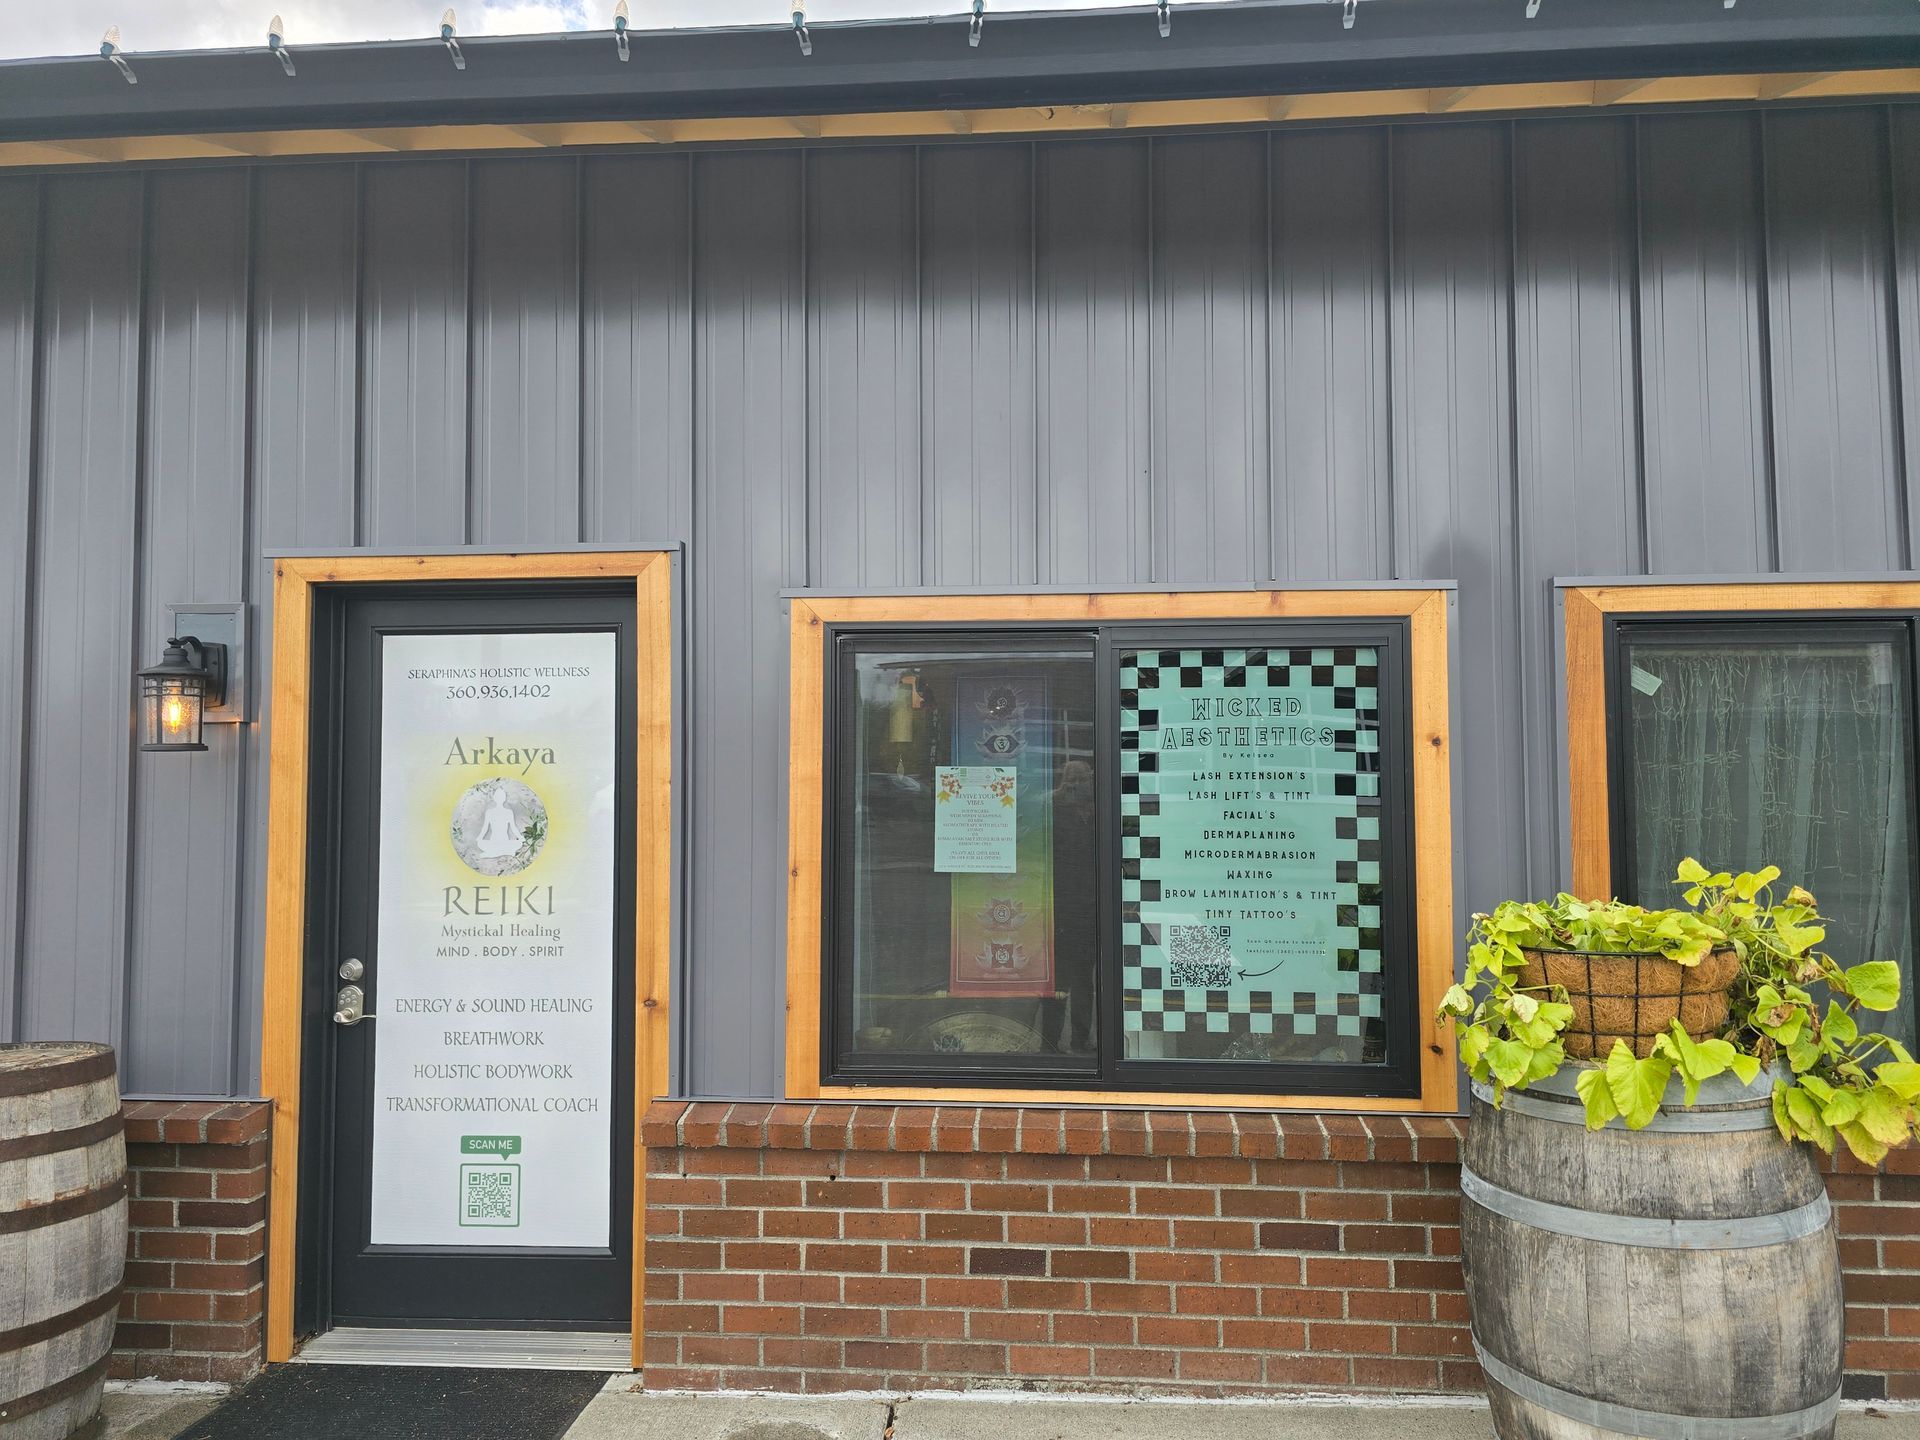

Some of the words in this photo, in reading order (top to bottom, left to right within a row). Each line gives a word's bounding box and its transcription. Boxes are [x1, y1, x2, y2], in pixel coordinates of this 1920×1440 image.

[407, 668, 477, 680] SERAPHINA'S
[479, 667, 531, 679] HOLISTIC
[533, 666, 590, 678] WELLNESS
[446, 684, 552, 701] 360.936.1402
[1191, 696, 1302, 722] WICKED
[1160, 725, 1335, 750] AESTHETICS
[443, 736, 557, 776] Arkaya
[1191, 771, 1222, 781] LASH
[1227, 770, 1306, 781] EXTENSION'S
[1187, 790, 1218, 801] LASH
[1223, 790, 1264, 802] LIFT'S
[1267, 791, 1277, 801] &
[1282, 791, 1311, 802] TINT
[1222, 809, 1276, 821] FACIAL'S
[1202, 829, 1297, 841] DERMAPLANING
[1183, 849, 1317, 861] MICRODERMABRASION
[1225, 869, 1274, 880] WAXING
[443, 885, 556, 918] REIKI
[1164, 888, 1197, 900] BROW
[1202, 889, 1289, 901] LAMINATION'S
[1295, 890, 1304, 900] &
[1309, 890, 1338, 901] TINT
[1204, 908, 1233, 920] TINY
[1239, 909, 1297, 920] TATTOO'S
[440, 925, 504, 942] Mystickal
[509, 925, 561, 941] Healing
[436, 946, 471, 957] MIND
[481, 946, 517, 957] BODY
[528, 945, 565, 957] SPIRIT
[395, 998, 453, 1013] ENERGY
[455, 999, 467, 1013] &
[471, 998, 526, 1014] SOUND
[530, 998, 594, 1014] HEALING
[443, 1030, 545, 1047] BREATHWORK
[413, 1064, 481, 1080] HOLISTIC
[485, 1064, 573, 1080] BODYWORK
[386, 1096, 539, 1113] TRANSFORMATIONAL
[543, 1097, 599, 1113] COACH
[468, 1139, 496, 1150] SCAN
[498, 1139, 513, 1150] ME
